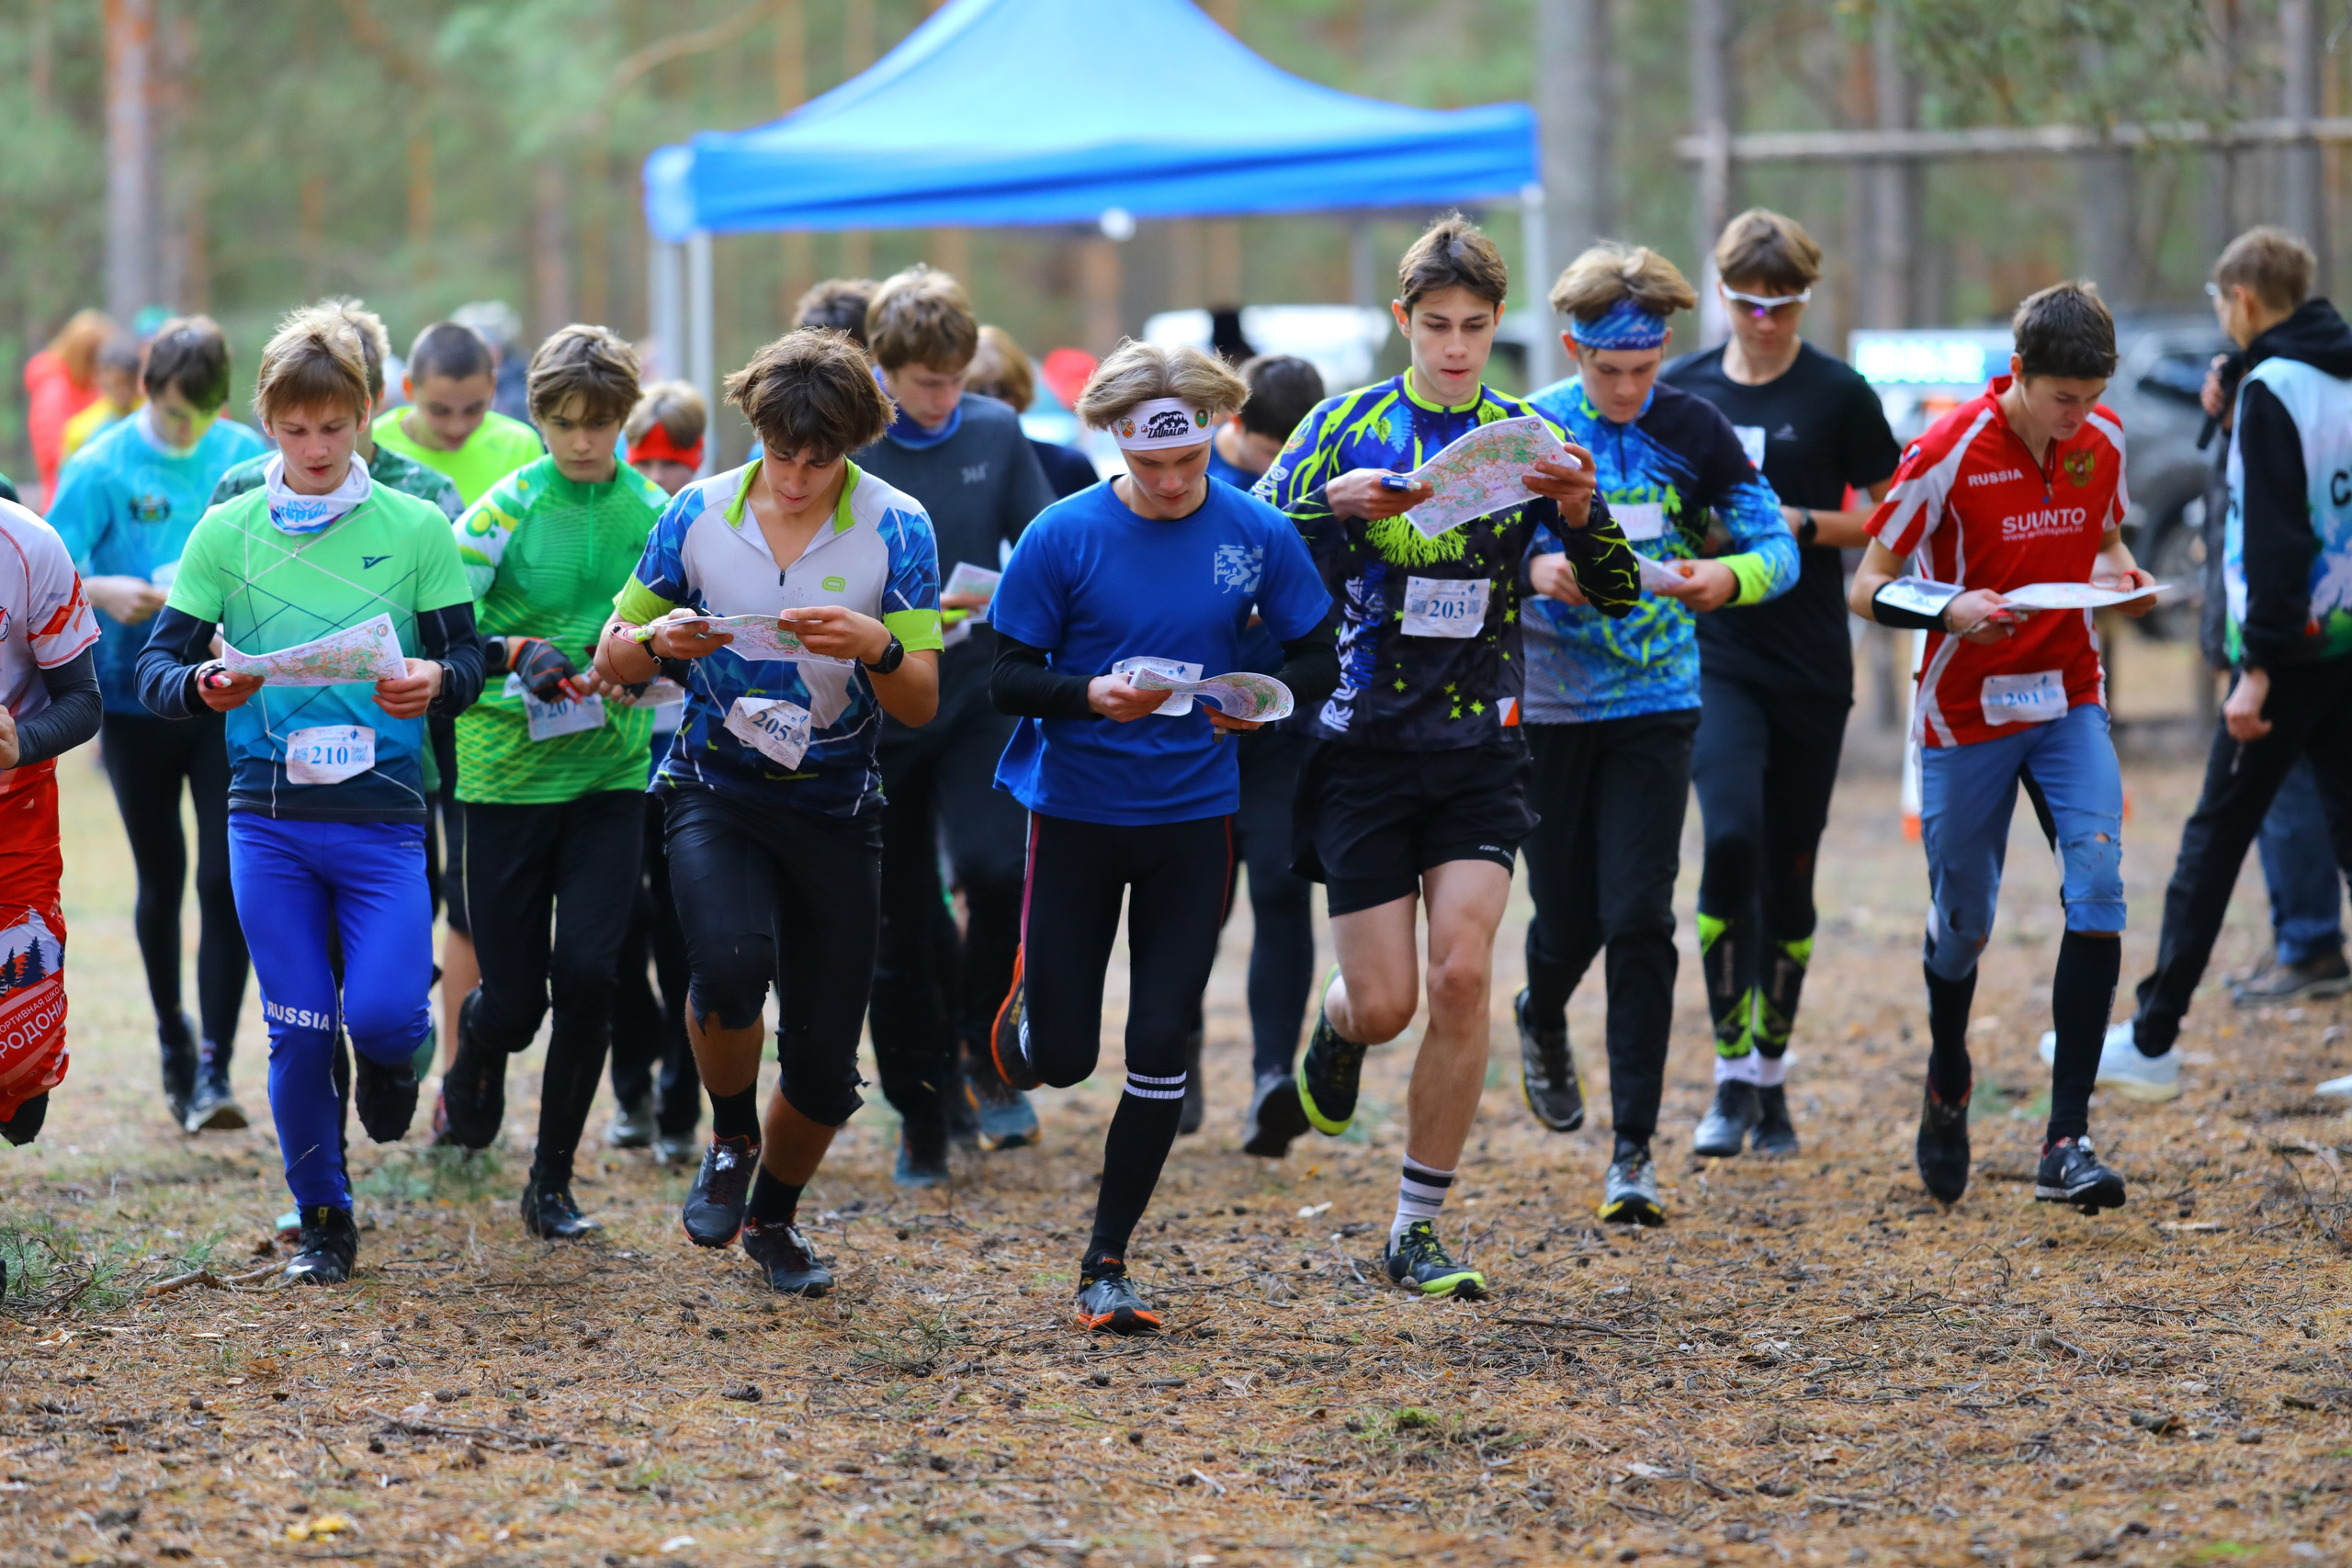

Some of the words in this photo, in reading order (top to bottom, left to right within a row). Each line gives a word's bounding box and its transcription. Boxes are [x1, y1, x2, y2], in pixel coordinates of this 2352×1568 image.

[1147, 425, 1189, 439] ZAURALOM
[1967, 468, 2023, 487] RUSSIA
[2002, 507, 2086, 534] SUUNTO
[1428, 599, 1465, 619] 203
[2006, 691, 2040, 707] 201
[752, 710, 792, 741] 205
[311, 745, 349, 765] 210
[0, 998, 45, 1034] ОРТИВНАЯ
[266, 999, 330, 1031] RUSSIA
